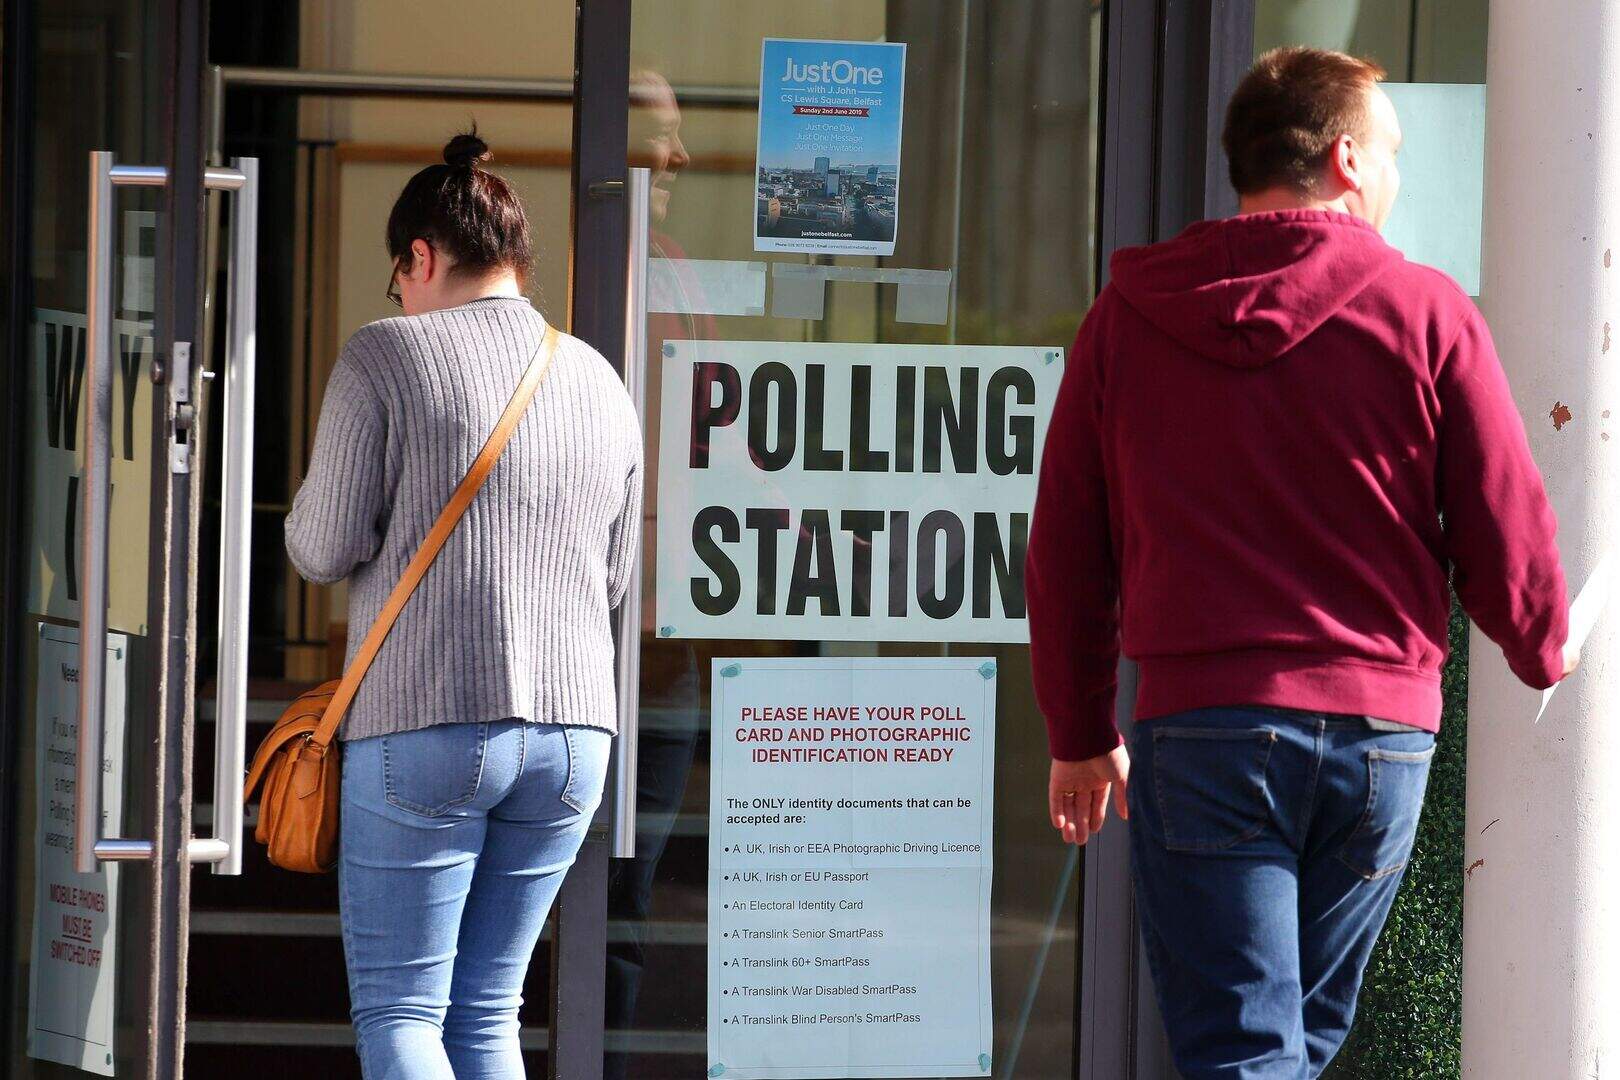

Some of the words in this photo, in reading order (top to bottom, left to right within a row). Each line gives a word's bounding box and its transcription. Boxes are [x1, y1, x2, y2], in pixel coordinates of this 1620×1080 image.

[781, 57, 883, 85] JustOne
[806, 86, 826, 94] with
[780, 94, 793, 102] CS
[794, 95, 819, 104] Lewis
[820, 96, 851, 106] Square,
[853, 97, 882, 106] Belfast
[800, 107, 821, 115] Sunday
[805, 123, 821, 132] Just
[822, 124, 838, 132] One
[839, 124, 855, 133] Day
[813, 134, 829, 142] One
[830, 135, 863, 144] Message
[793, 143, 810, 151] Just
[811, 143, 828, 151] One
[829, 144, 863, 152] Invitation
[45, 322, 143, 461] WY
[689, 361, 1036, 476] POLLING
[690, 505, 1028, 620] STATION
[741, 707, 808, 721] PLEASE
[813, 707, 860, 721] HAVE
[865, 707, 915, 721] YOUR
[920, 706, 966, 721] POLL
[735, 728, 783, 742] CARD
[788, 728, 825, 742] AND
[830, 727, 971, 742] PHOTOGRAPHIC
[752, 748, 888, 763] IDENTIFICATION
[894, 748, 954, 762] READY
[727, 798, 749, 809] The
[752, 798, 785, 809] ONLY
[788, 798, 833, 811] identity
[837, 798, 903, 809] documents
[906, 798, 930, 809] that
[932, 800, 954, 808] can
[957, 797, 971, 808] be
[727, 814, 780, 826] accepted
[783, 815, 807, 824] are:
[732, 844, 741, 853] A
[746, 844, 765, 855] UK,
[769, 843, 791, 853] Irish
[793, 845, 804, 853] or
[807, 844, 831, 853] EEA
[833, 843, 900, 856] Photographic
[903, 843, 938, 855] Driving
[941, 842, 981, 853] Licence
[732, 872, 741, 882] A
[743, 872, 762, 883] UK,
[765, 872, 788, 882] Irish
[790, 873, 801, 882] or
[804, 872, 821, 882] EU
[824, 871, 869, 884] Passport
[50, 883, 77, 906] MOBILE
[80, 890, 104, 913] PHONES
[732, 901, 746, 910] An
[749, 900, 795, 911] Electoral
[798, 900, 836, 912] Identity
[839, 900, 863, 910] Card
[62, 914, 82, 935] MUST
[83, 918, 92, 938] BE
[731, 929, 741, 939] A
[742, 929, 789, 939] Translink
[792, 928, 826, 938] Senior
[829, 928, 884, 939] SmartPass
[51, 939, 86, 964] SWITCHED
[731, 958, 740, 968] A
[742, 957, 789, 968] Translink
[791, 957, 811, 967] 60+
[814, 957, 870, 967] SmartPass
[731, 987, 740, 996] A
[742, 986, 789, 996] Translink
[791, 986, 812, 996] War
[815, 985, 859, 996] Disabled
[862, 984, 917, 995] SmartPass
[731, 1015, 740, 1025] A
[742, 1014, 788, 1025] Translink
[791, 1014, 816, 1024] Blind
[820, 1013, 863, 1024] Person's
[866, 1013, 921, 1023] SmartPass
